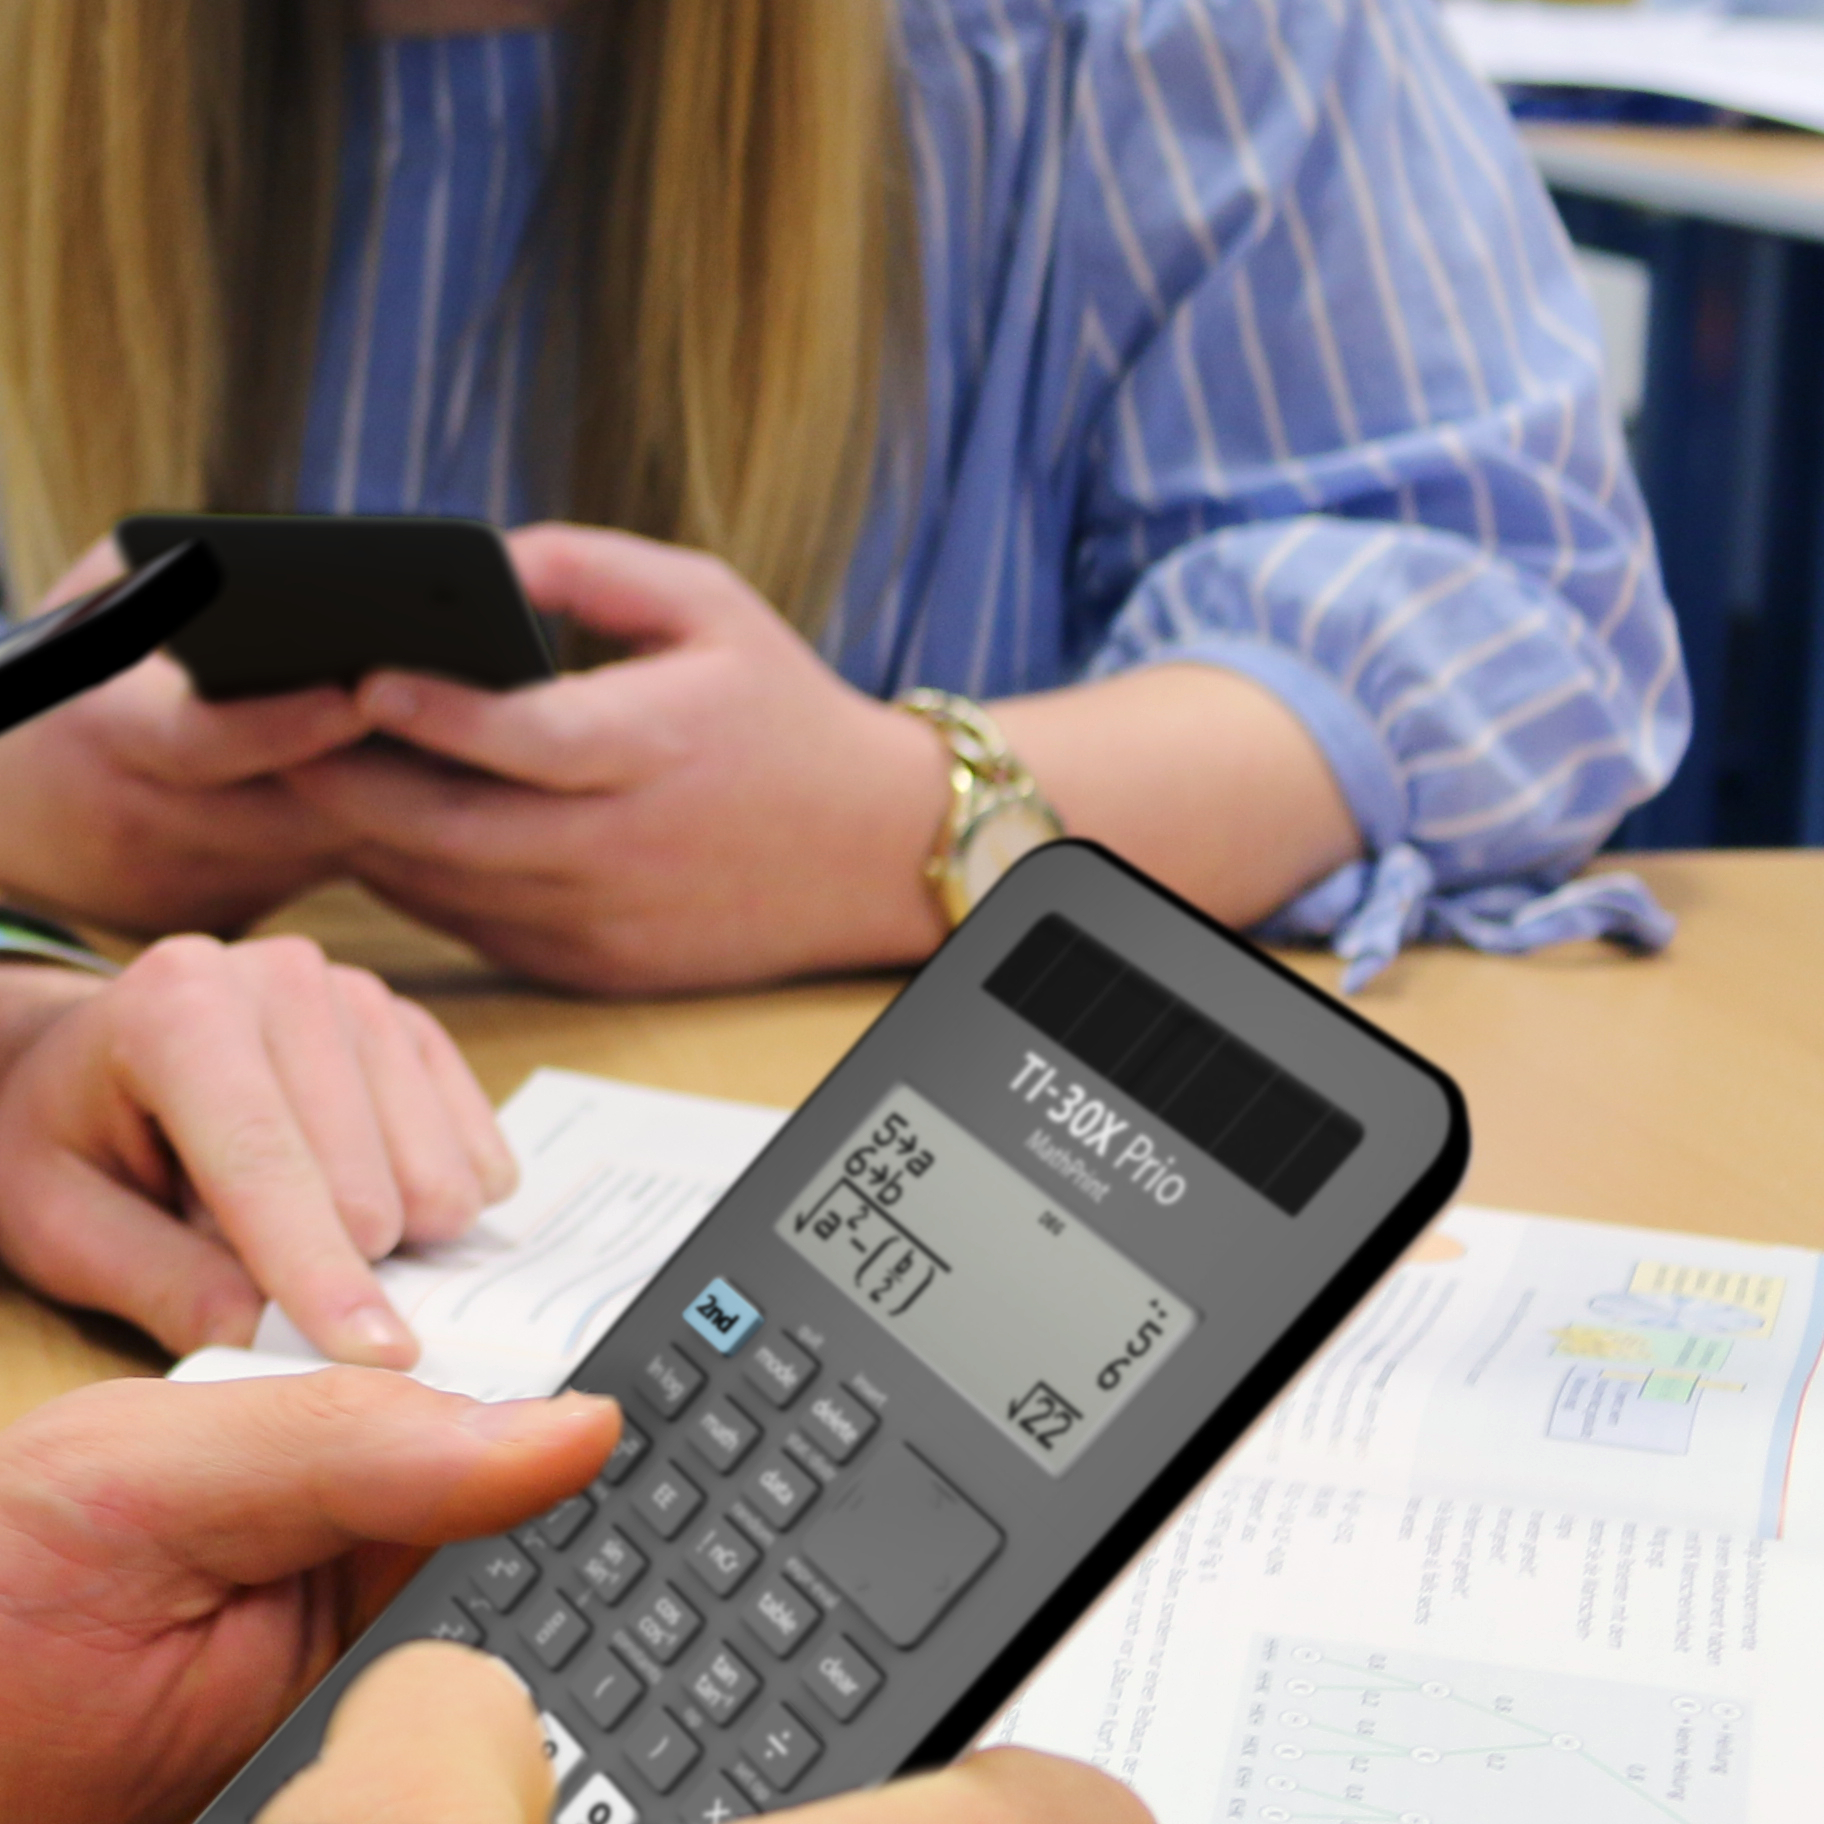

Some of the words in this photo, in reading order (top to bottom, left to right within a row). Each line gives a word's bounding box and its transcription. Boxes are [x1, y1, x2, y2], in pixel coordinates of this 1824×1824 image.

[1009, 1051, 1129, 1158] TI-30X
[1114, 1133, 1187, 1206] Prio
[1023, 1128, 1111, 1204] MathPrint
[695, 1293, 741, 1334] 2nd
[1125, 1319, 1164, 1360] 5
[659, 1367, 685, 1402] log
[754, 1345, 798, 1389] mode
[1095, 1356, 1132, 1392] 6
[701, 1411, 739, 1452] math
[810, 1397, 858, 1444] delete
[758, 1467, 795, 1507] data
[599, 1537, 626, 1566] sin
[707, 1543, 740, 1574] nCr
[654, 1596, 682, 1626] cos
[757, 1590, 797, 1635] table
[710, 1653, 740, 1687] tan
[818, 1655, 860, 1697] clear
